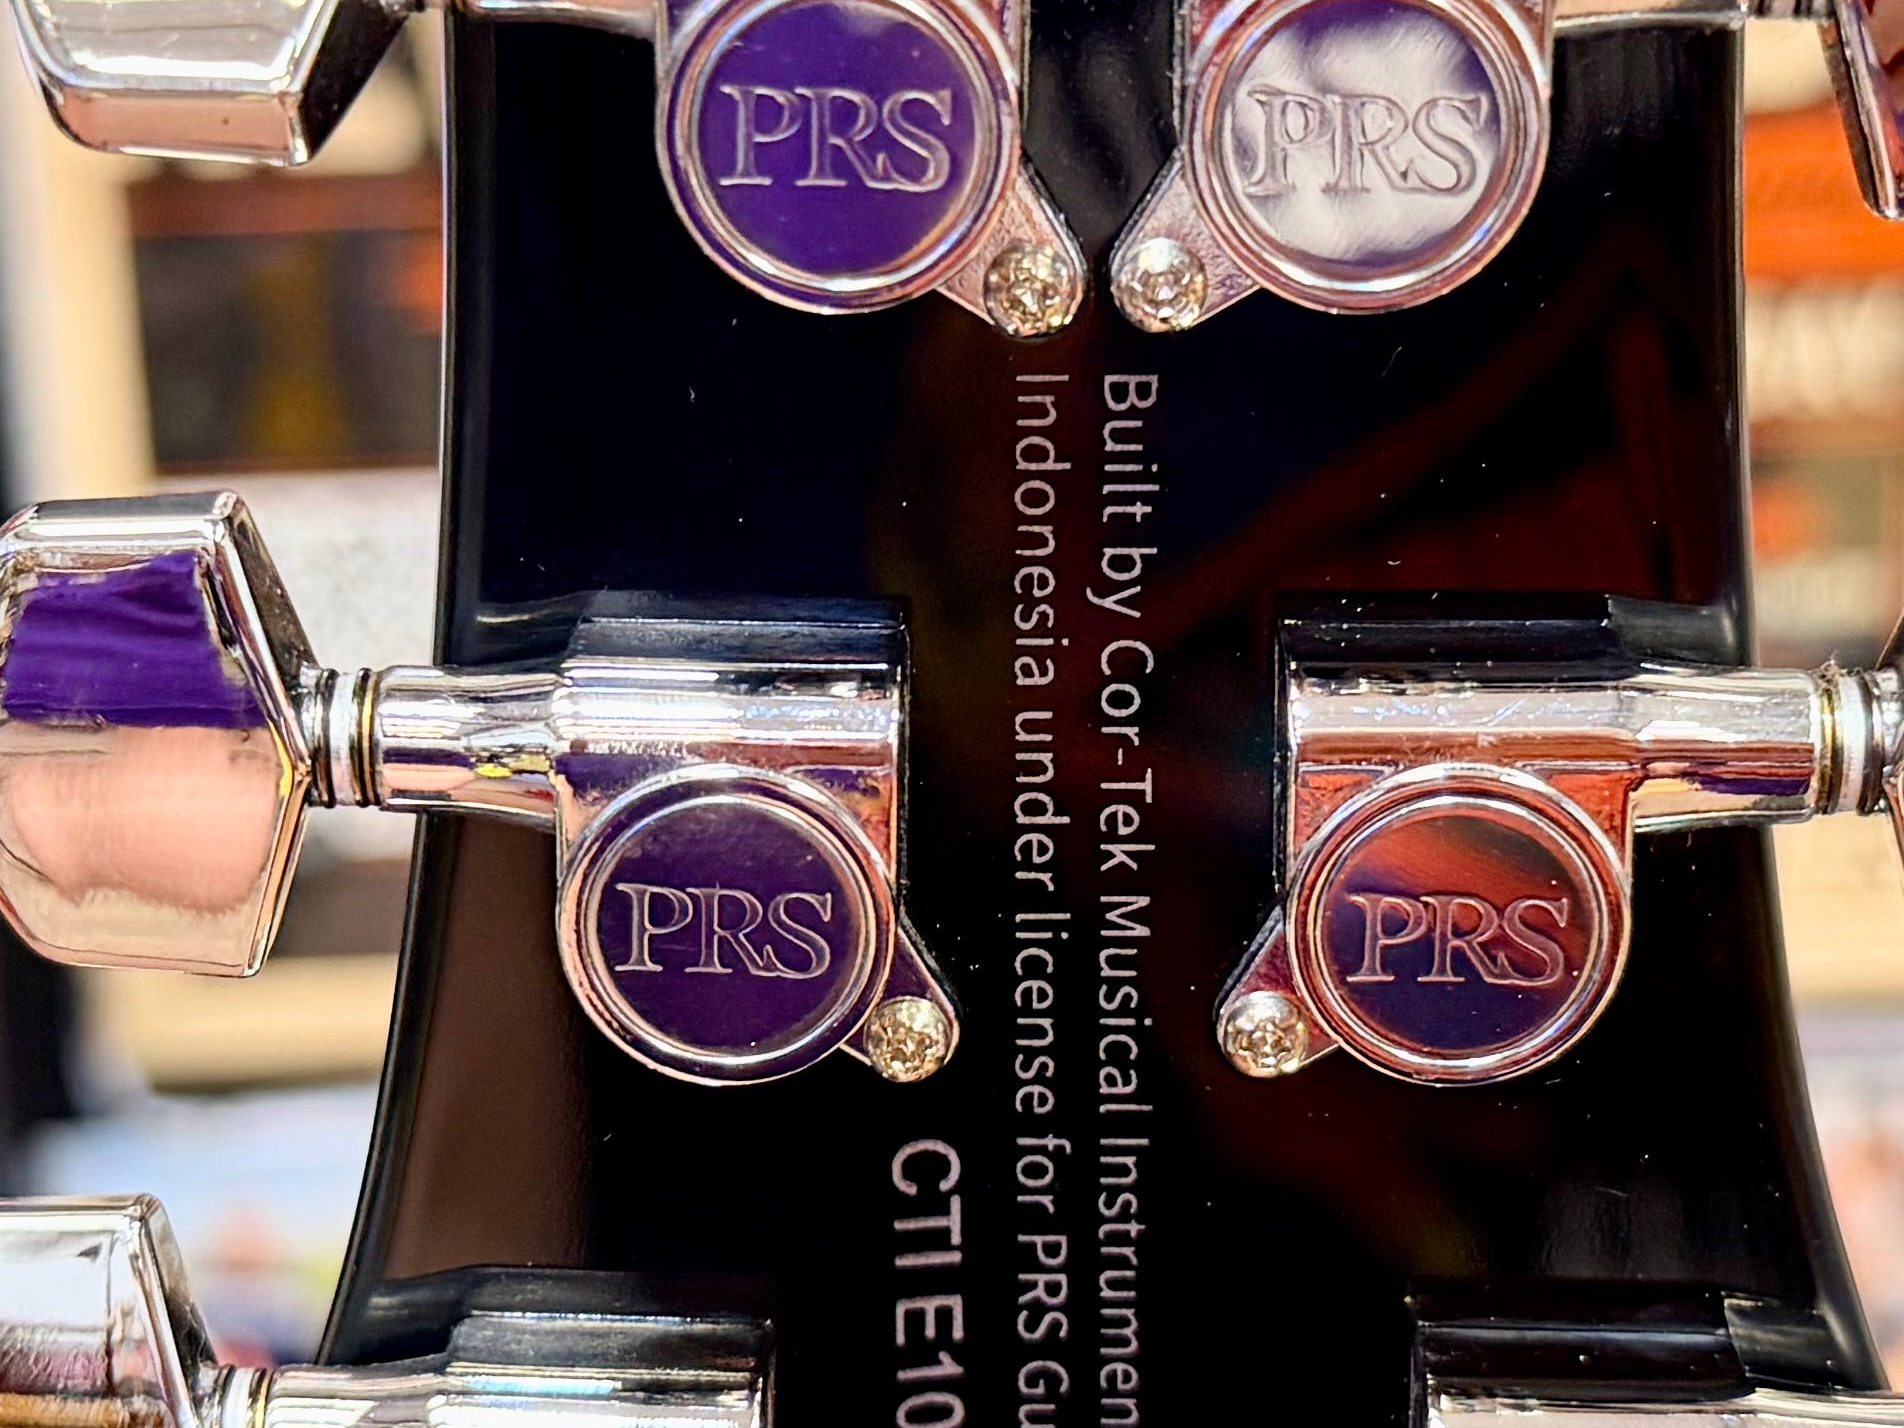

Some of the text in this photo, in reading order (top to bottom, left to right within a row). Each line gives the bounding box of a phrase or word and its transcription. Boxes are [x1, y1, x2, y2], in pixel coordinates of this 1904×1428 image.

[718, 84, 953, 193] PRS
[1246, 81, 1488, 197] PRS
[1101, 374, 1161, 523] Built
[1013, 374, 1072, 686] Indonesia
[1085, 547, 1158, 619] by
[1013, 710, 1071, 892] under
[1099, 639, 1156, 872] Cor-Tek
[614, 882, 834, 978] PRS
[1345, 891, 1570, 986] PRS
[1014, 912, 1072, 1114] license
[1098, 895, 1153, 1114] Musical
[891, 1139, 963, 1267] CTI
[1015, 1133, 1072, 1214] for
[1016, 1233, 1069, 1340] PRS
